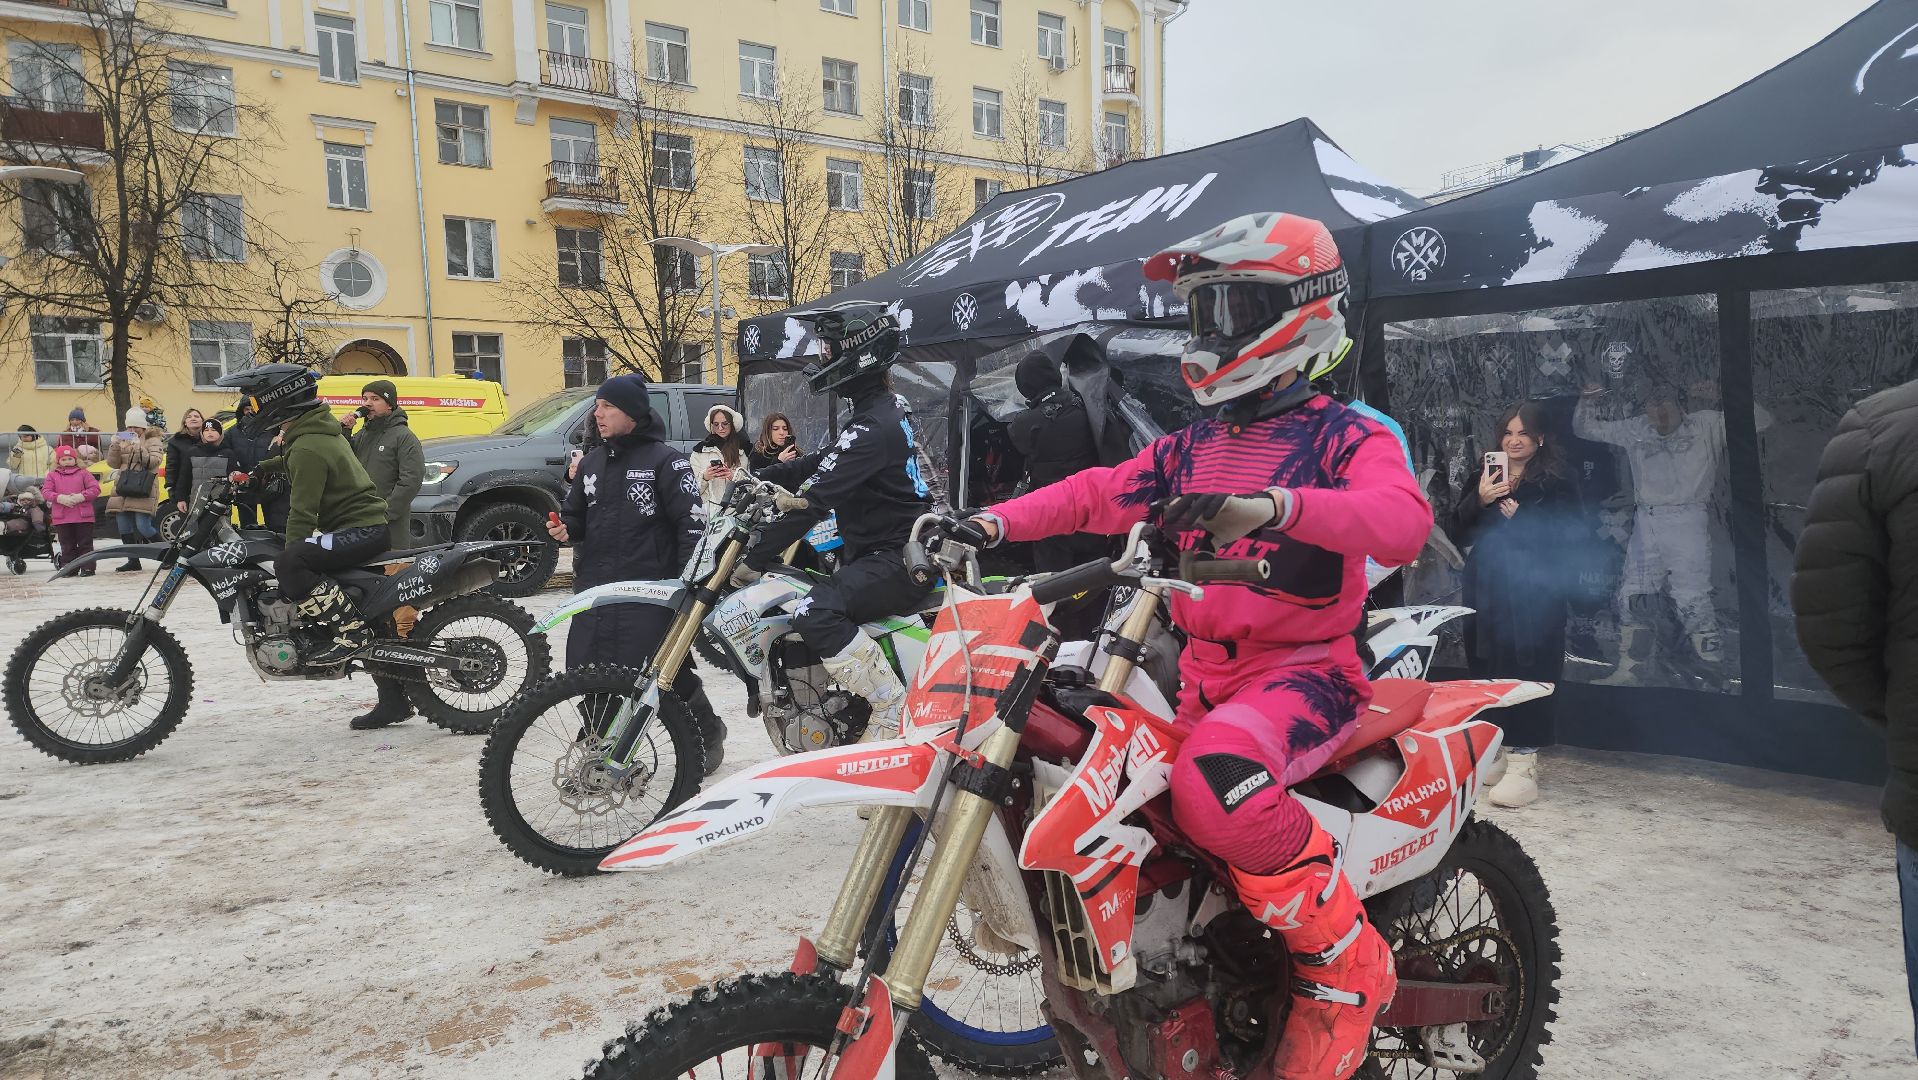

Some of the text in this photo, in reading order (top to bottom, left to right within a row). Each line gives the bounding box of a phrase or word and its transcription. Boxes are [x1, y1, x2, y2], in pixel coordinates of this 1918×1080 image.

[1019, 172, 1218, 266] TEAM
[1289, 264, 1349, 306] WHITEL
[839, 317, 890, 351] WHITELAB
[260, 378, 307, 404] WHITELAB
[439, 398, 479, 407] ЖИЗНЬ
[399, 584, 433, 602] GLOVES
[837, 753, 913, 775] JUSTCAT
[1383, 777, 1448, 815] TRXLHXD
[696, 816, 764, 845] TRXLHXD
[1369, 828, 1439, 875] JUSTCAT
